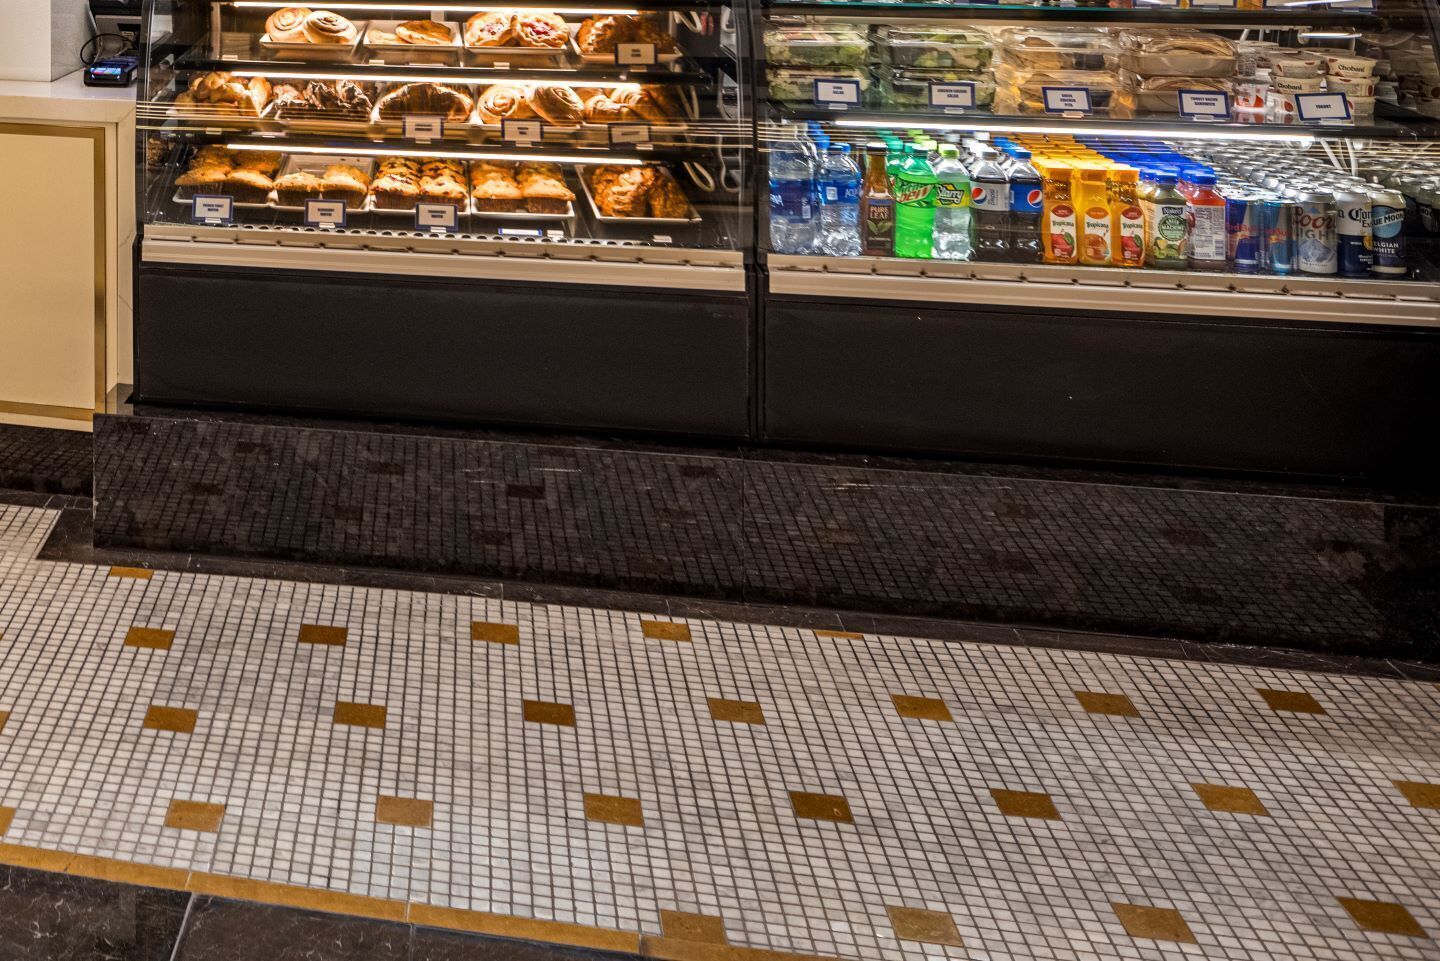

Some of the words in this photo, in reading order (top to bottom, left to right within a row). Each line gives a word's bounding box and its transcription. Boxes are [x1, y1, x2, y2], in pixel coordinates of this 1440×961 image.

[1337, 64, 1365, 73] Chobani
[1278, 83, 1302, 91] Chobani
[936, 185, 963, 203] Starry
[870, 206, 889, 214] PURE
[1384, 212, 1405, 223] MOON
[1086, 221, 1109, 229] Tropicana
